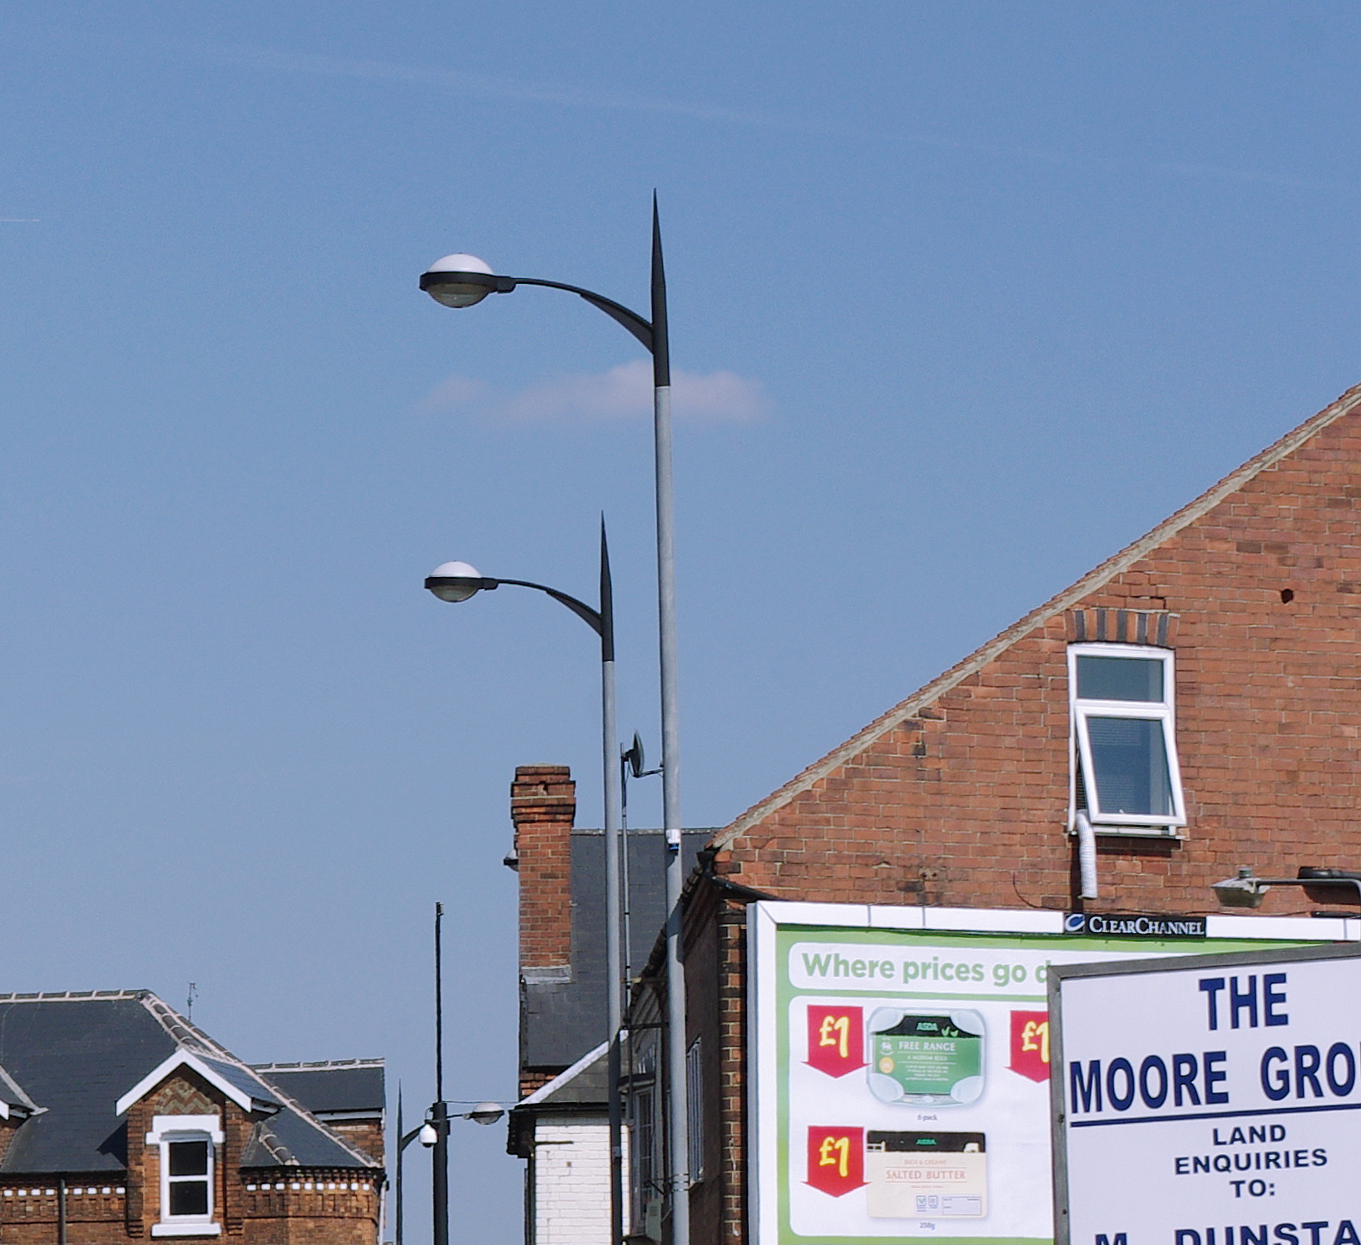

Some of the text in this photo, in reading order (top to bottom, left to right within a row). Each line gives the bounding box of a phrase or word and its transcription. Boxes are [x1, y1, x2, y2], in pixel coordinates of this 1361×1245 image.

[802, 953, 895, 979] Where
[902, 957, 985, 984] prices
[992, 964, 1027, 987] go
[1198, 972, 1289, 1031] THE
[819, 1016, 850, 1059] £1
[916, 1022, 938, 1031] ASDA
[898, 1041, 956, 1052] FREE RANGE
[1021, 1021, 1049, 1063] £1
[1069, 1041, 1361, 1114] MOORE GRO
[1212, 1124, 1287, 1146] LAND
[819, 1136, 850, 1178] £1
[1174, 1148, 1328, 1175] ENQUIRIES
[886, 1170, 966, 1180] SALTED BUTTER
[1229, 1179, 1276, 1198] TO:
